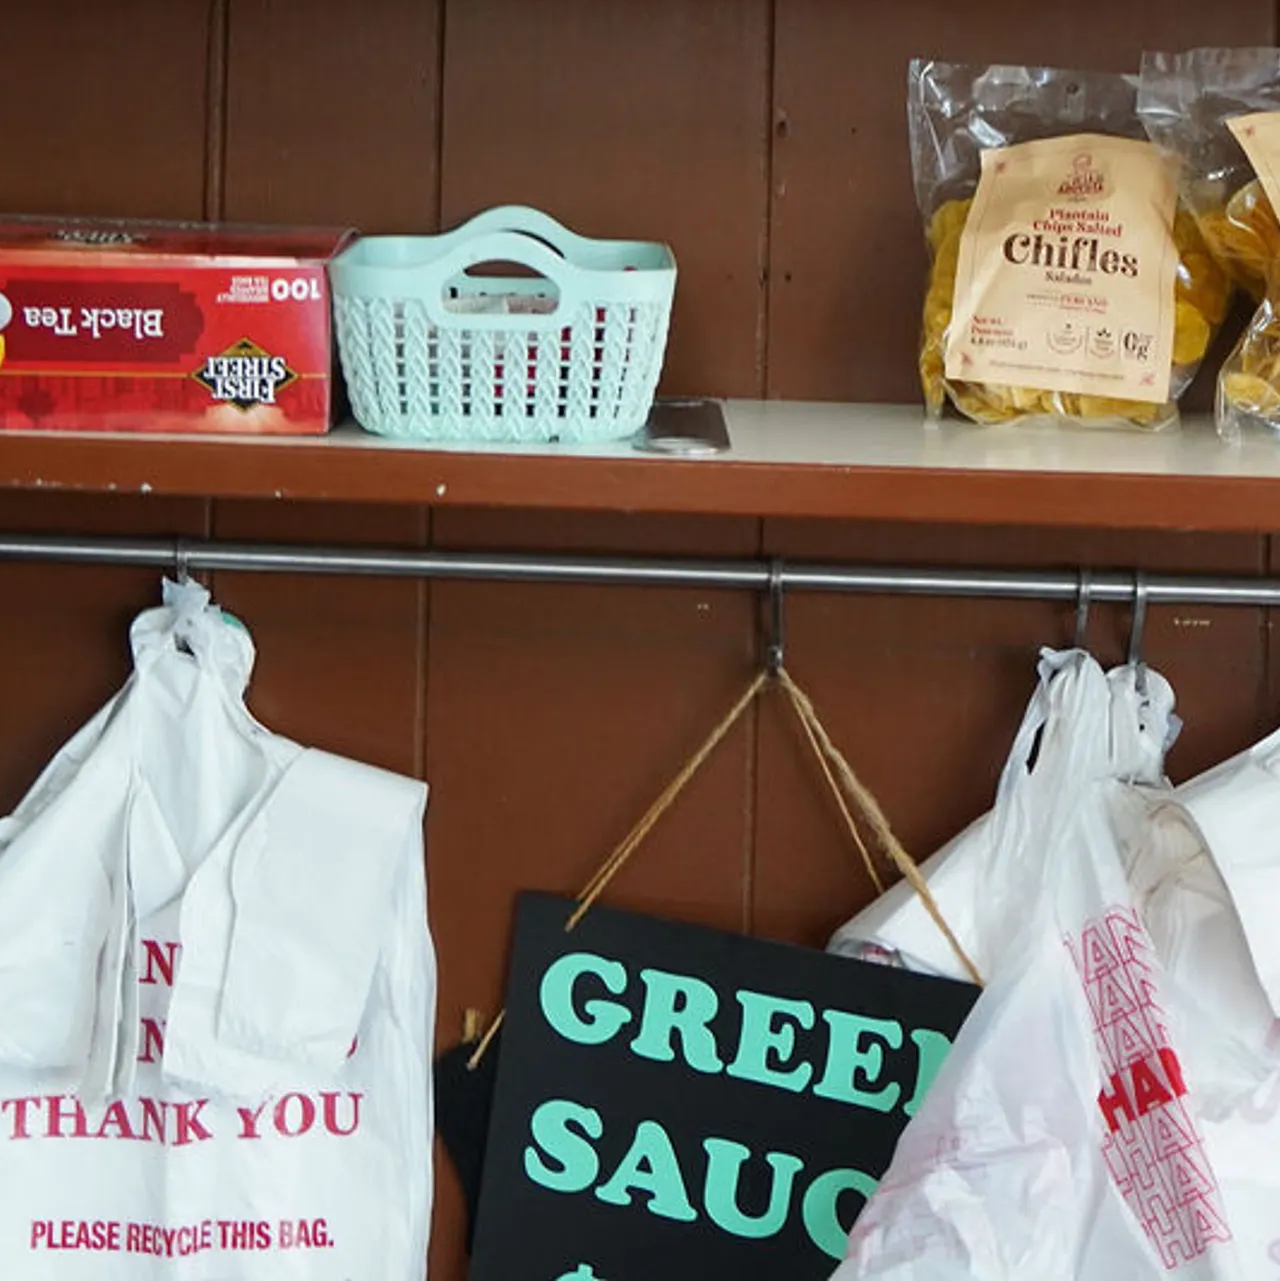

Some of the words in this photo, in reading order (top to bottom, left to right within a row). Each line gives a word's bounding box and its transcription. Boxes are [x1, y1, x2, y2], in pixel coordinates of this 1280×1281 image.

[1002, 232, 1139, 278] Chifles
[272, 277, 322, 301] 100
[22, 306, 78, 337] Tea
[81, 307, 164, 339] Black
[202, 355, 287, 381] STREET
[211, 377, 278, 405] FIRST
[1, 1093, 214, 1146] THANK
[236, 1091, 365, 1140] YOU
[523, 1098, 882, 1261] SAUC
[29, 1221, 121, 1252] PLEASE
[125, 1221, 213, 1258] RECYCLE
[216, 1220, 273, 1251] THIS
[277, 1218, 336, 1250] BAG.
